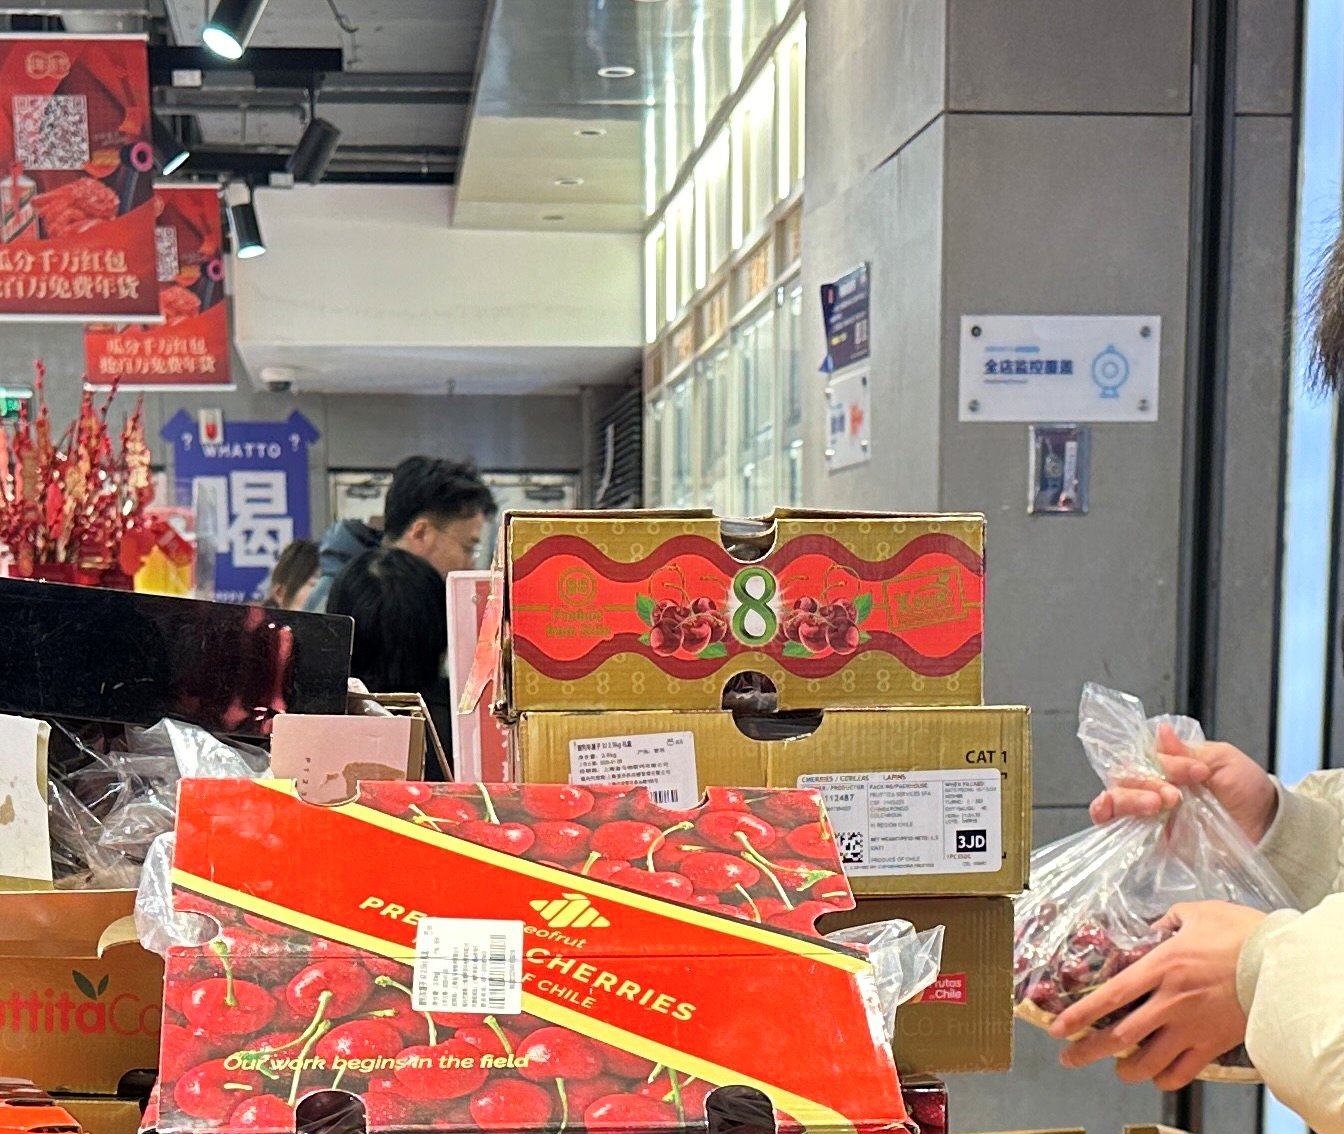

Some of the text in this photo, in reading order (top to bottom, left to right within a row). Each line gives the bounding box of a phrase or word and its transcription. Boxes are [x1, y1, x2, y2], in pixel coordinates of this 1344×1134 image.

[966, 751, 1006, 764] CAT 1
[957, 835, 985, 849] 3JD
[522, 922, 587, 950] eofrut
[524, 947, 698, 1022] CHERRIES
[535, 975, 598, 1010] CHILE
[935, 989, 962, 999] Chile
[224, 1053, 531, 1073] Our work begins in the field
